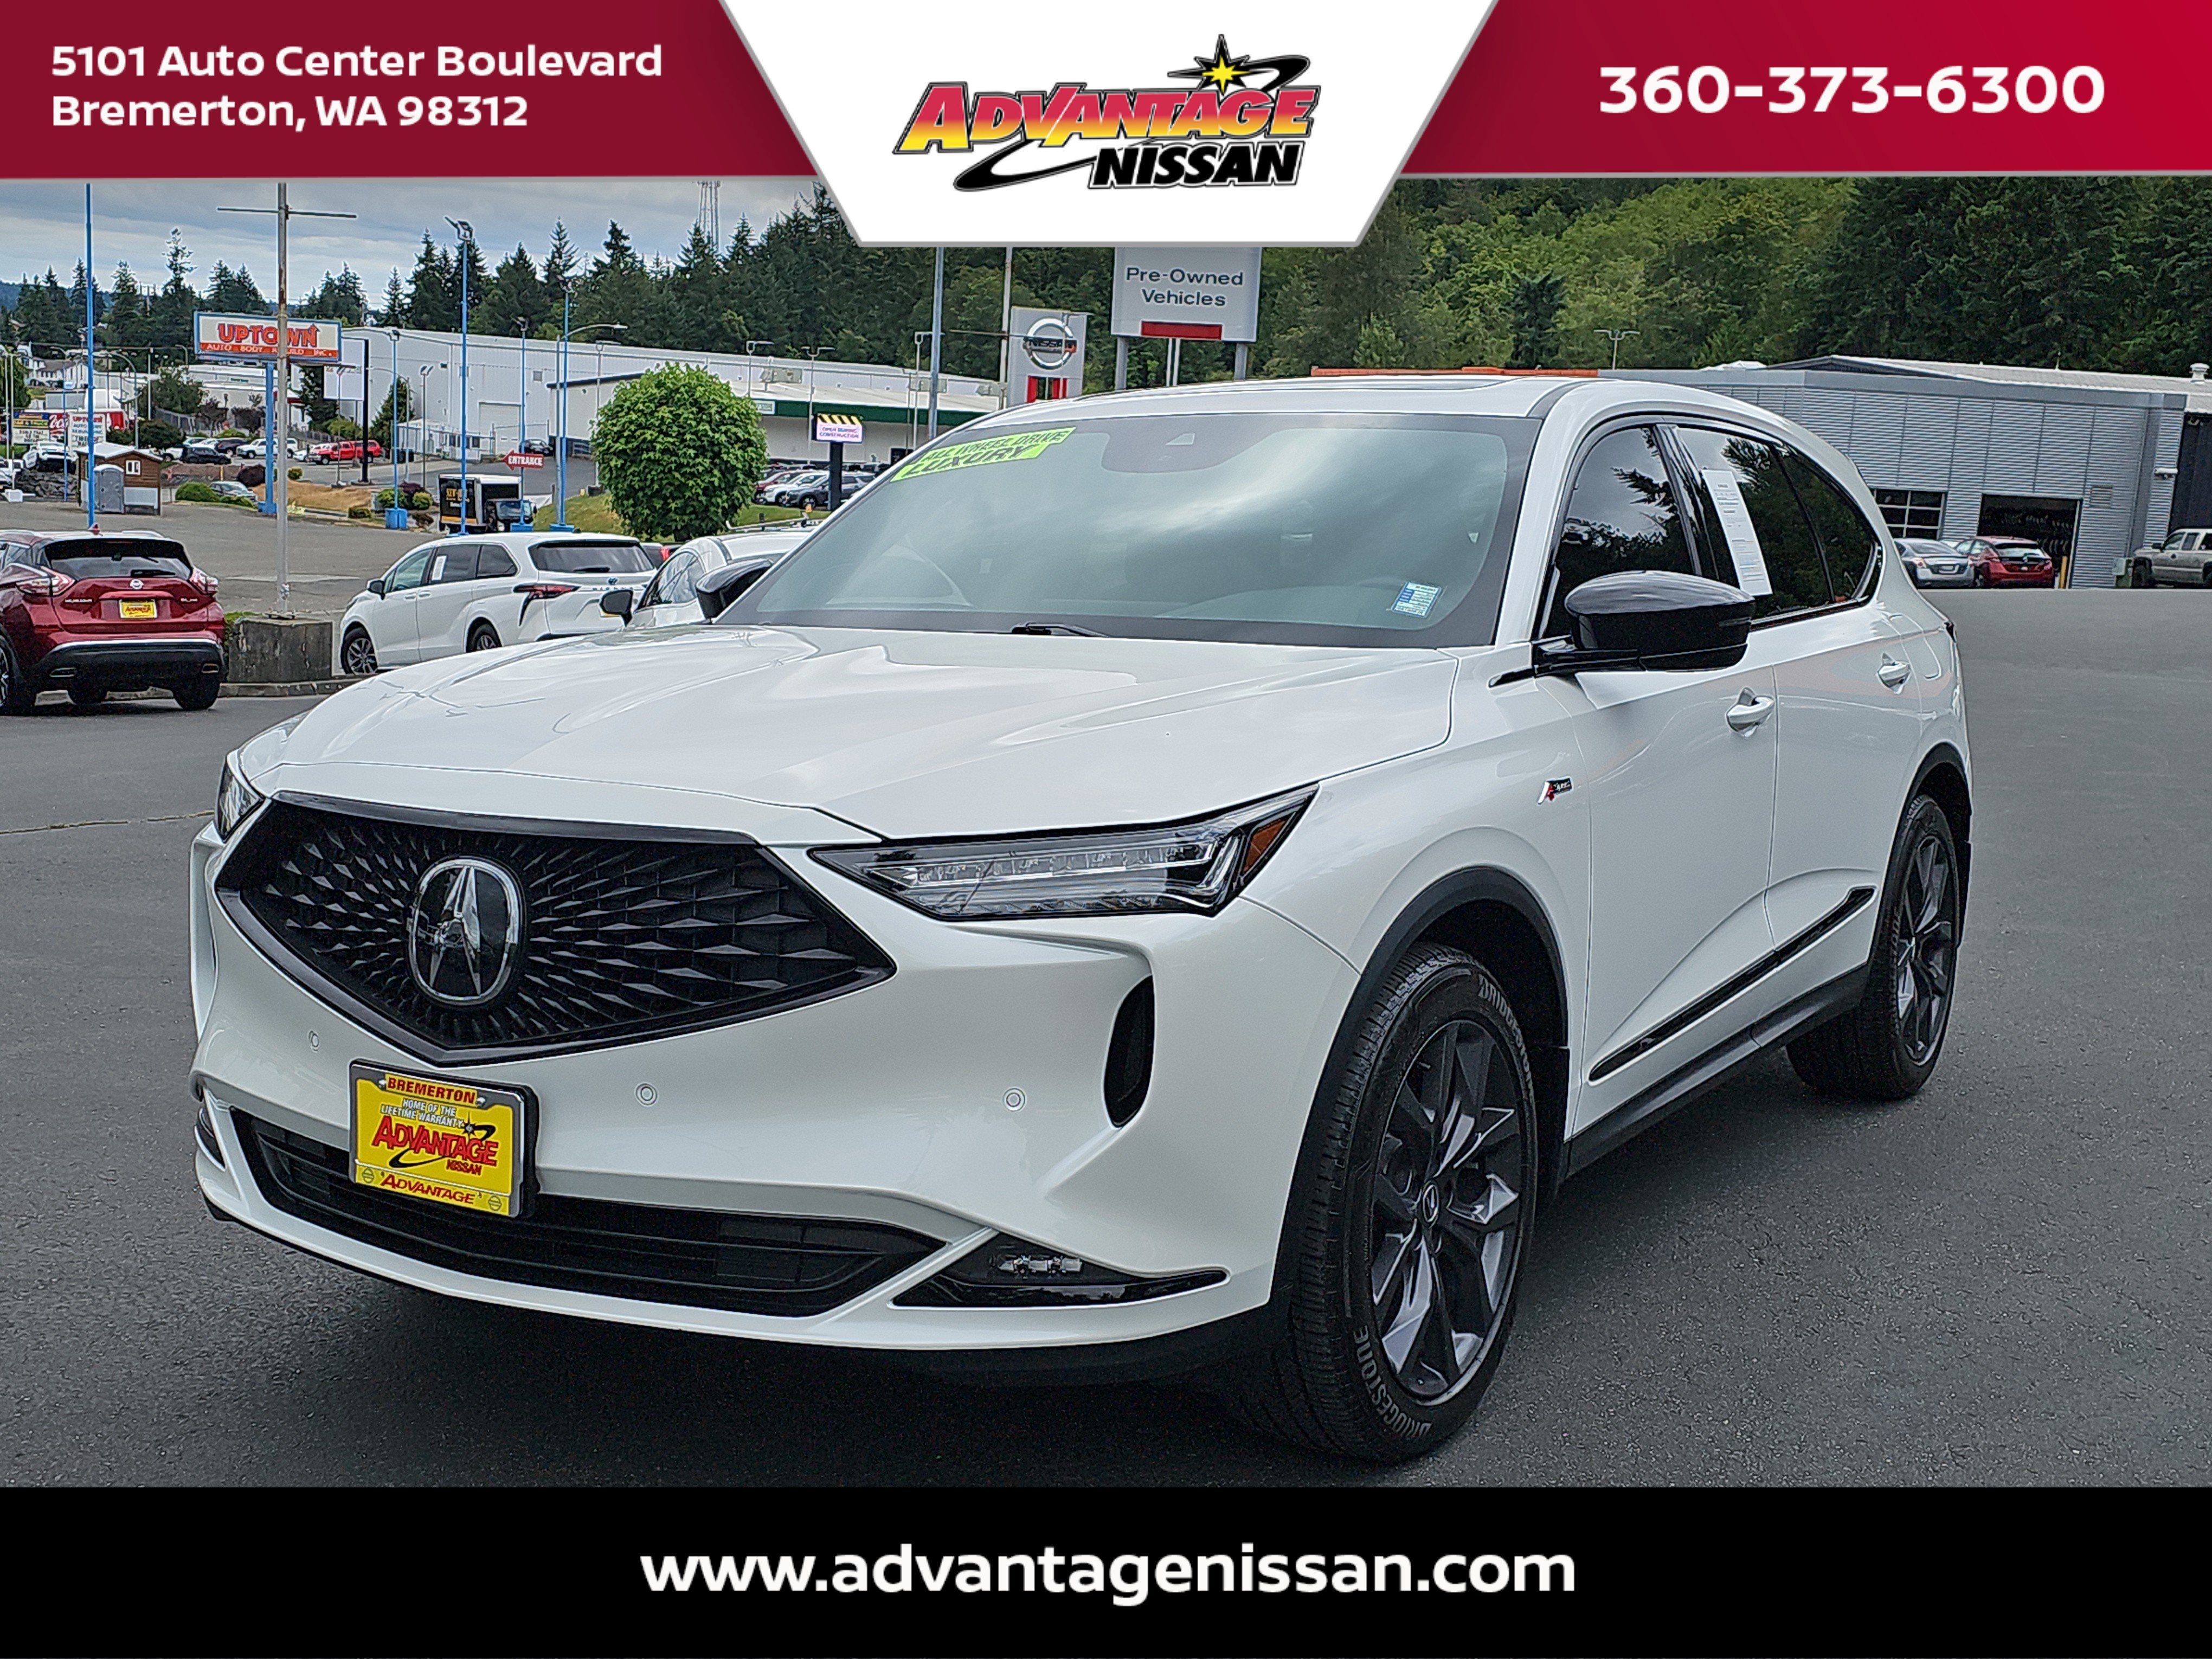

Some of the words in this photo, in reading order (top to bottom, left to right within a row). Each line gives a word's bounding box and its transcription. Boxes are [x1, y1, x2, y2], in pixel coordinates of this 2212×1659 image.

[1126, 267, 1243, 286] Pre-Owned
[1141, 288, 1226, 306] Vehicles
[206, 343, 232, 351] AUTO
[926, 448, 953, 461] ALL
[955, 438, 1011, 455] WHEEL
[1012, 430, 1070, 446] DRIVE
[508, 455, 543, 466] ENTRANCE
[387, 1077, 476, 1104] BREMERTON
[380, 1104, 417, 1120] LIFETIME
[418, 1112, 465, 1129] WARRANTY
[402, 1098, 426, 1111] HOME
[427, 1103, 438, 1113] OF
[440, 1105, 456, 1117] THE
[371, 1115, 499, 1167] ADVANTAGE
[446, 1159, 483, 1175] NISSAN
[1353, 1324, 1433, 1438] BRIDGESTONE
